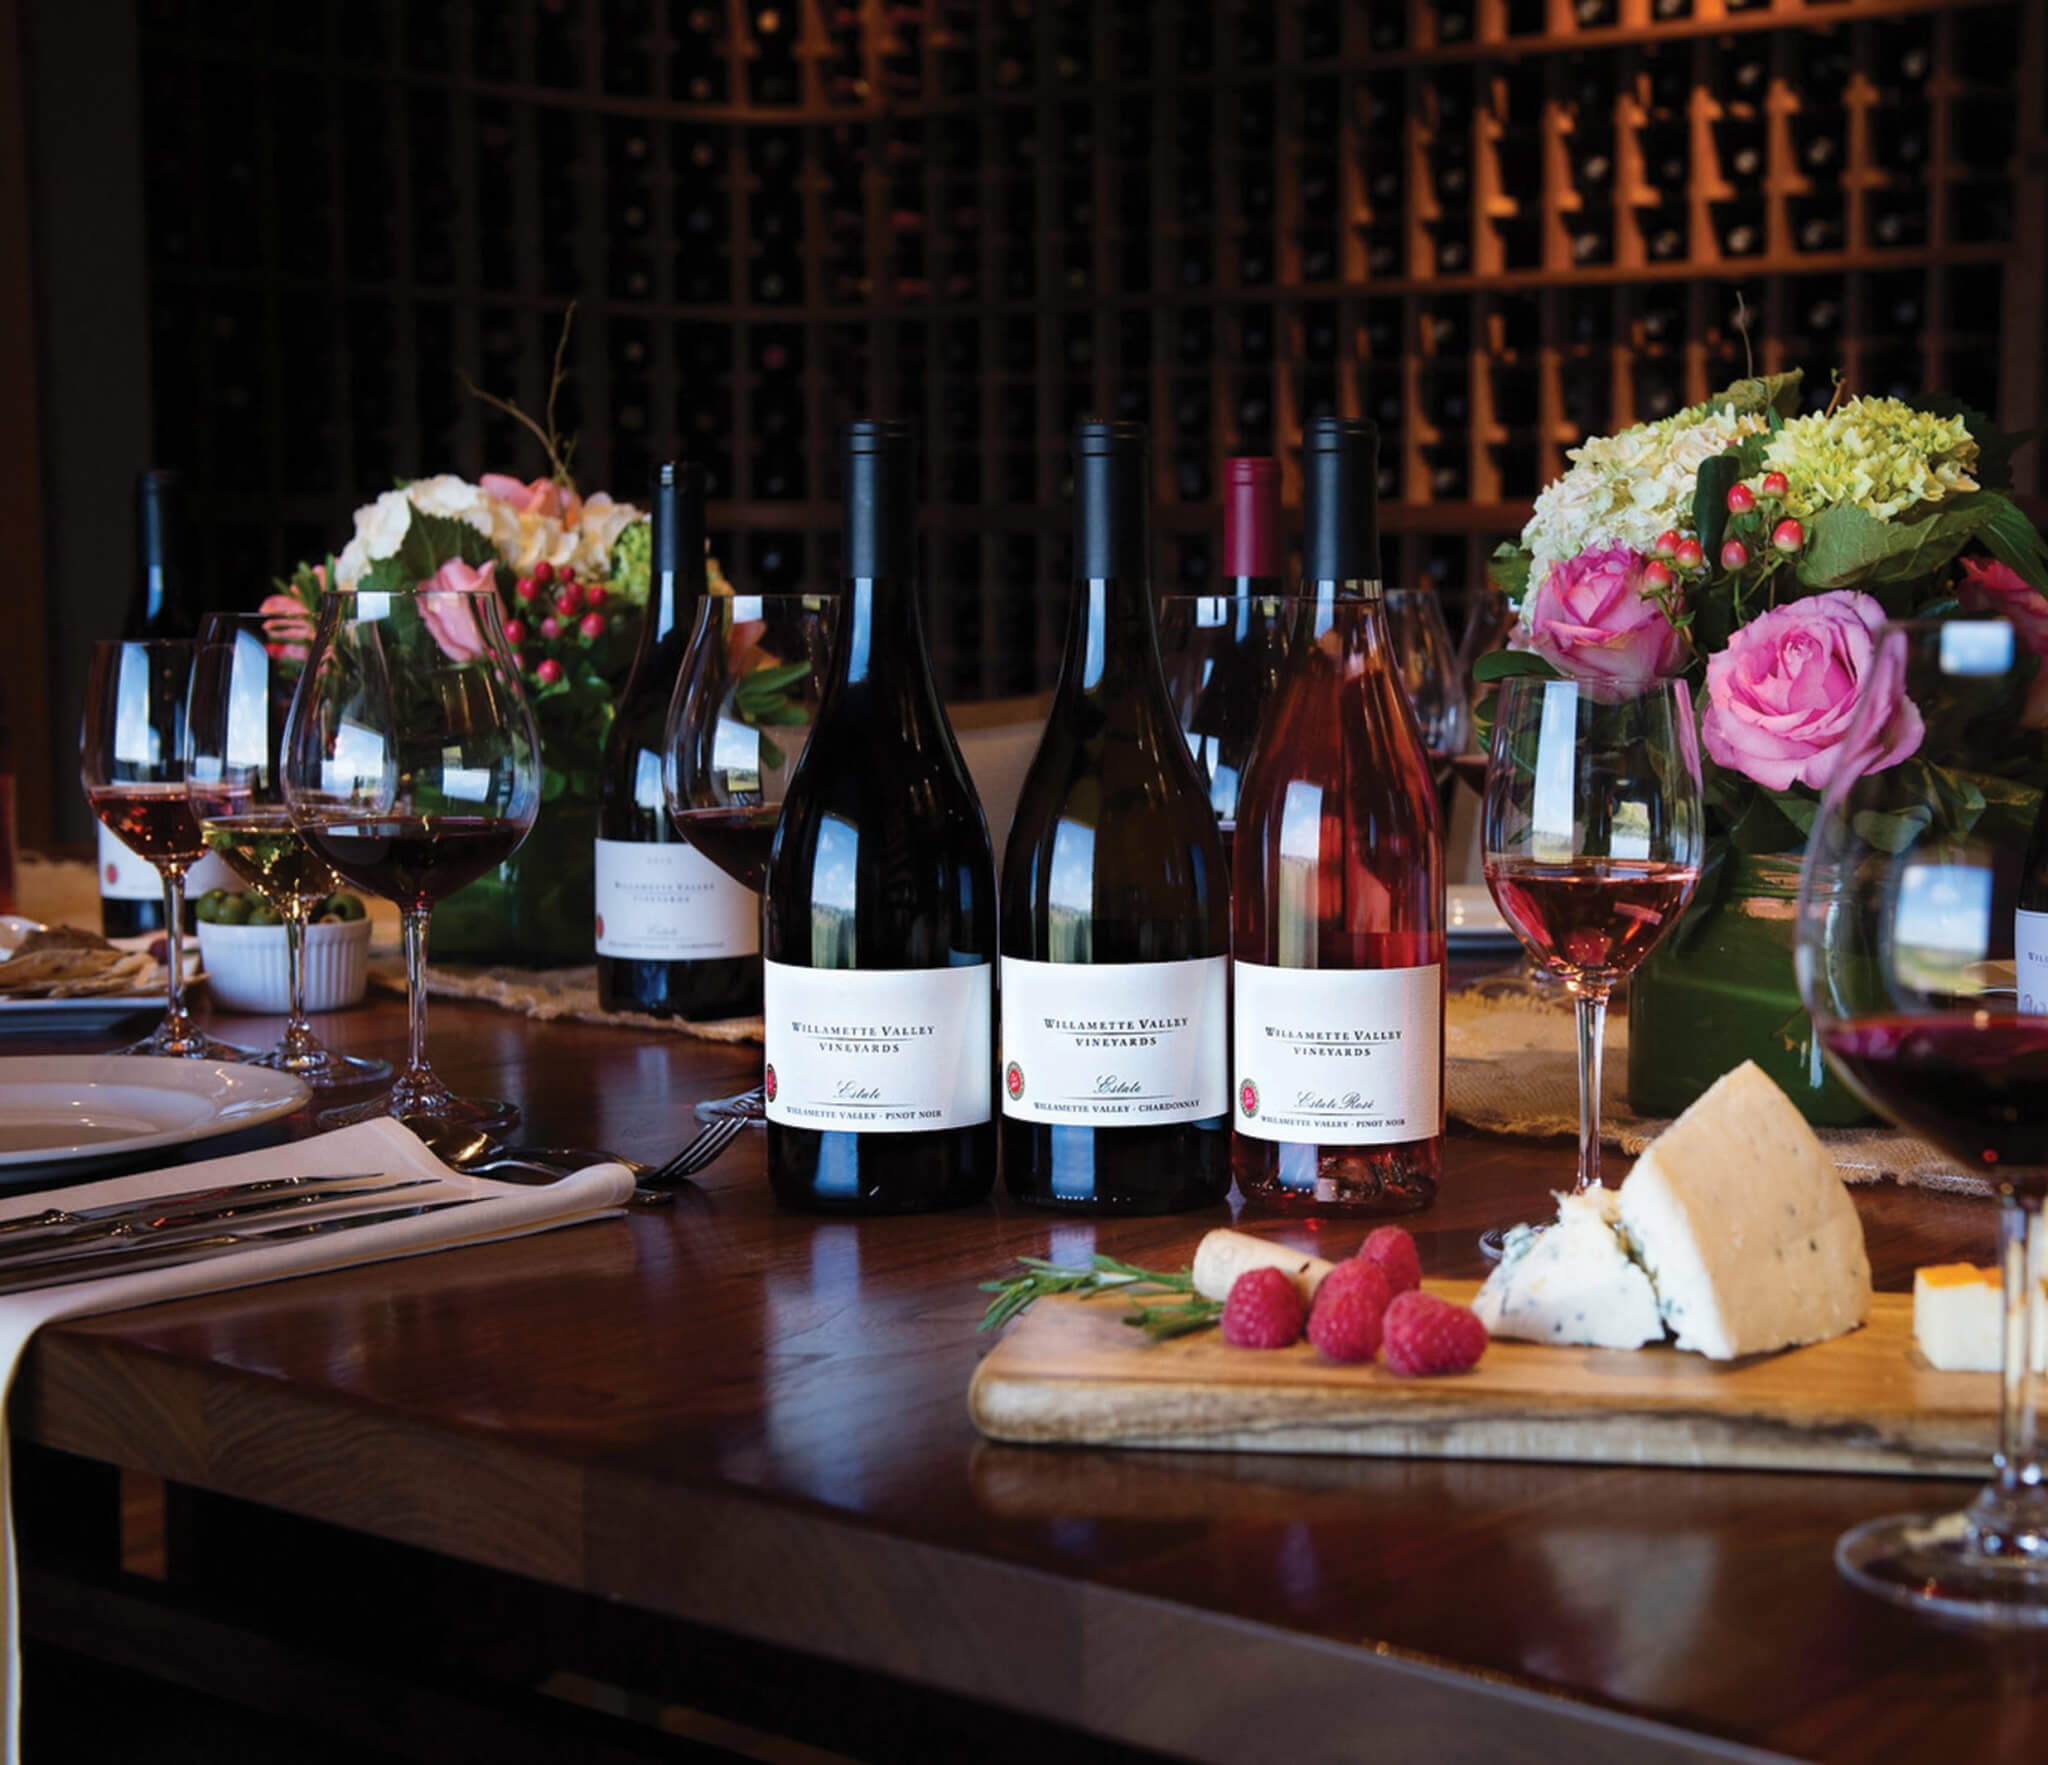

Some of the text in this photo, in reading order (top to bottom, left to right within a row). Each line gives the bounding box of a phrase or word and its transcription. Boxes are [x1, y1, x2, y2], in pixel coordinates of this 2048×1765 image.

[791, 1021, 936, 1037] WILLAMETTE VALLEY
[1043, 1016, 1189, 1031] WILLAMETTE VALLEY
[1264, 1026, 1403, 1041] WILLAMETTE VALLEY
[818, 1042, 901, 1053] VINEYARDS
[1075, 1037, 1157, 1048] VINEYARDS
[1292, 1046, 1372, 1057] VINEYARDS
[832, 1079, 881, 1099] Estate
[1092, 1074, 1143, 1094] Estate
[1032, 1099, 1201, 1114] WILLAMETTE VALLEY CHARDONNAY
[1294, 1090, 1337, 1109] Estate
[785, 1105, 943, 1121] WILLAMETTE VALLEY PINOT NOIR
[1261, 1114, 1406, 1128] WILLAMETTE VALLEY PINOT NOIR
